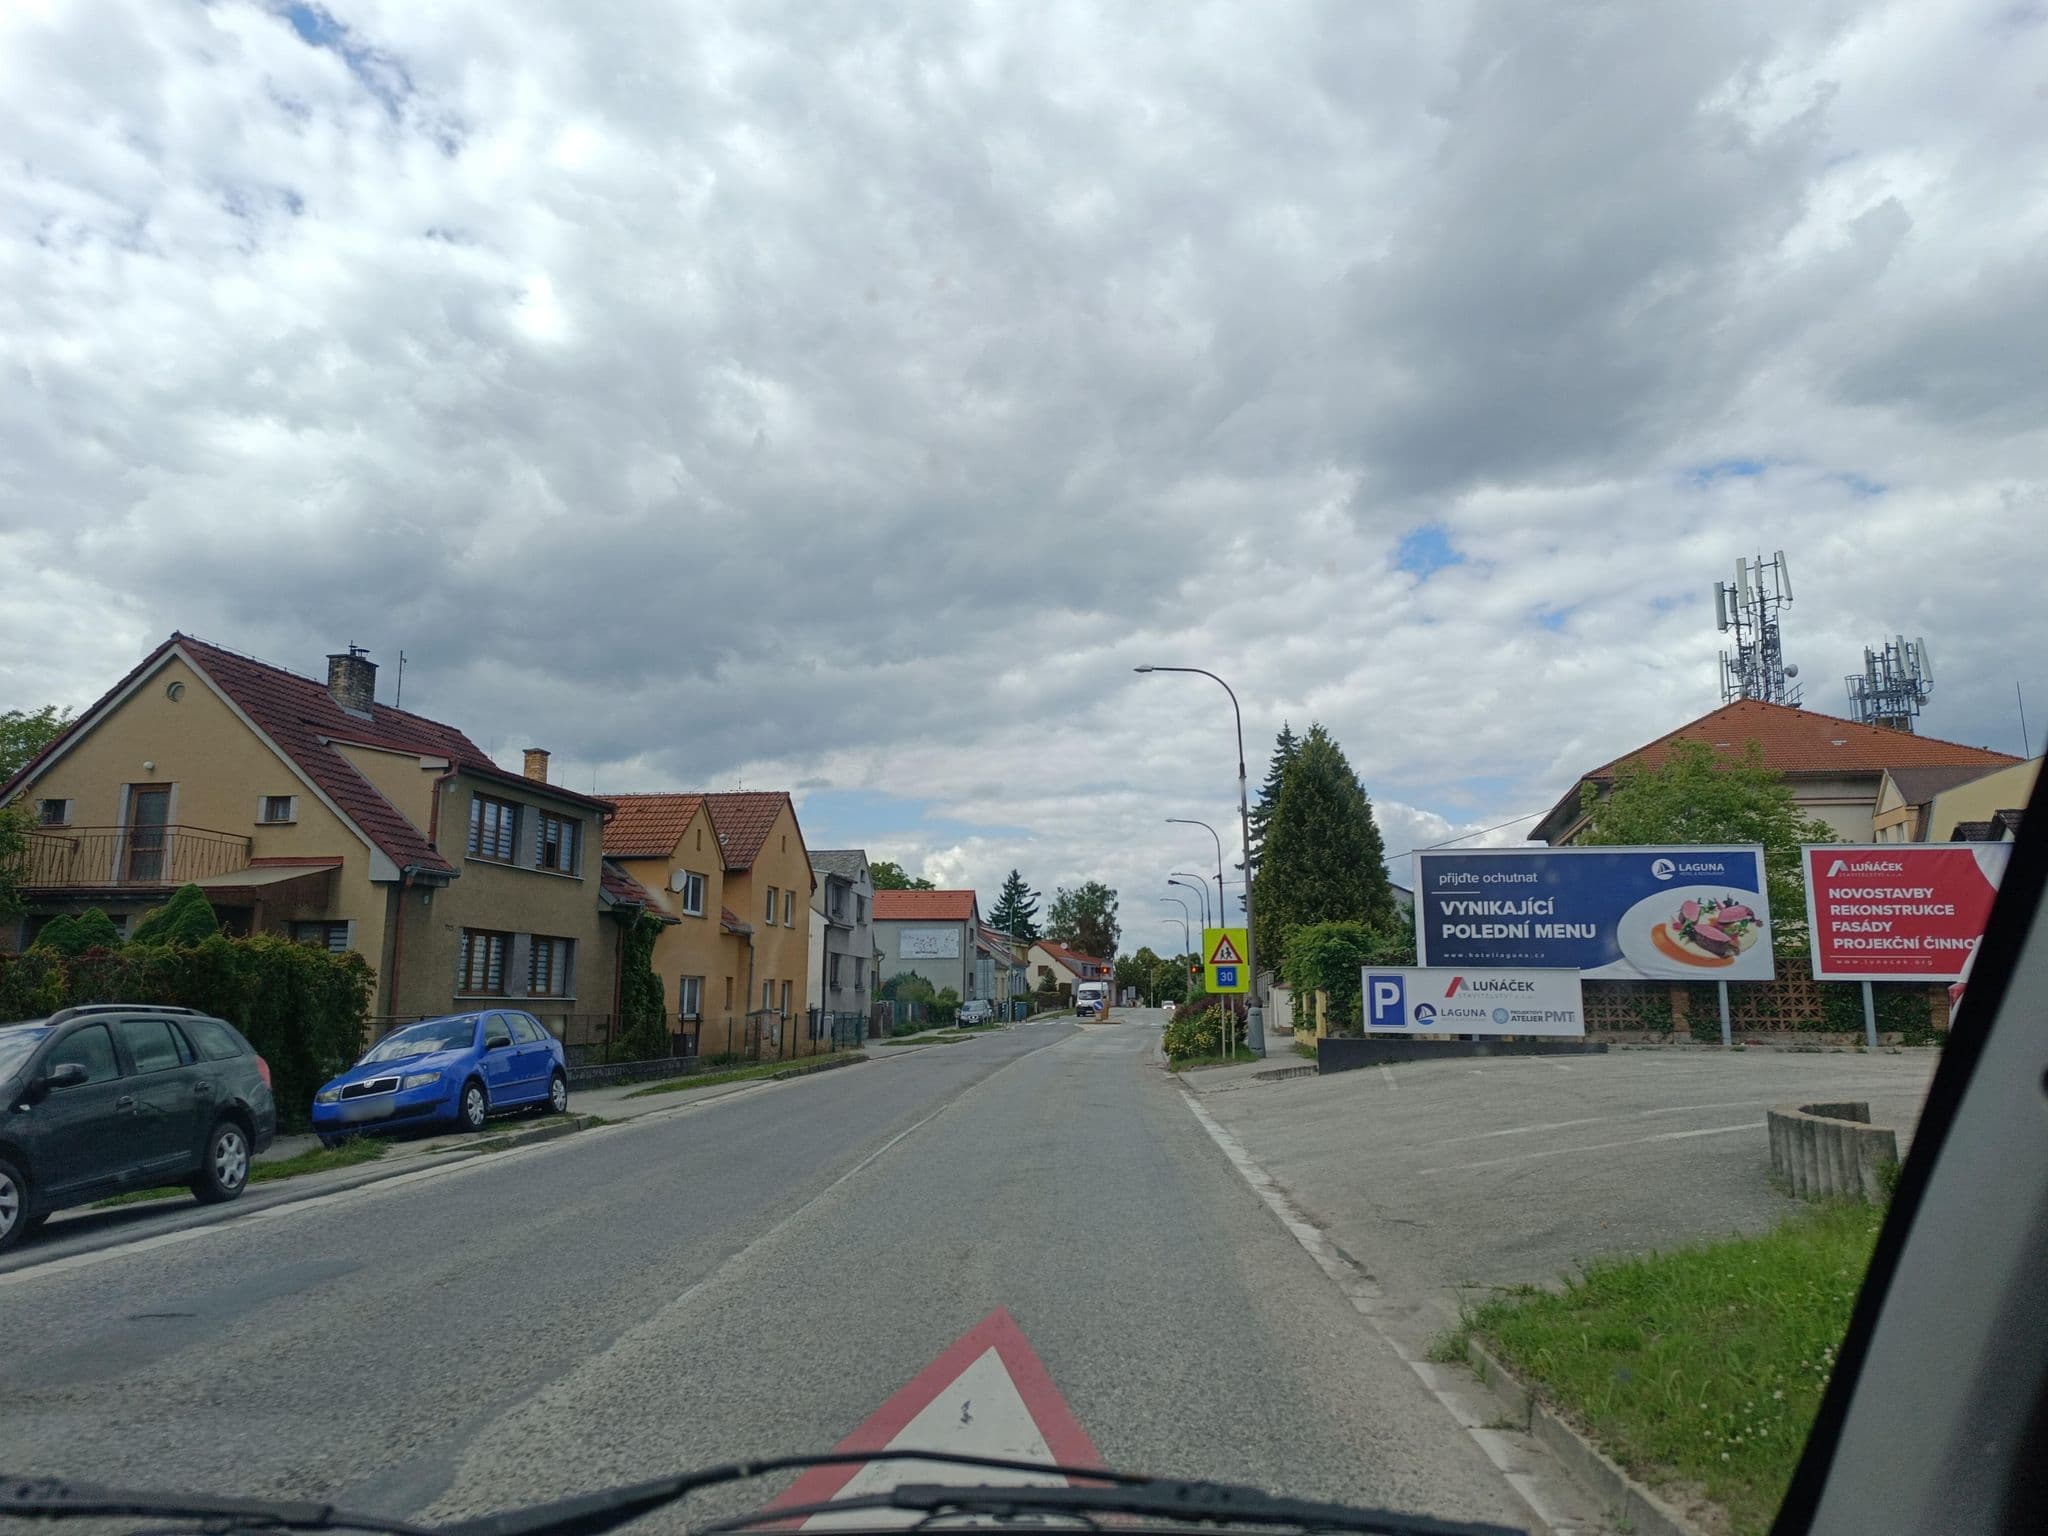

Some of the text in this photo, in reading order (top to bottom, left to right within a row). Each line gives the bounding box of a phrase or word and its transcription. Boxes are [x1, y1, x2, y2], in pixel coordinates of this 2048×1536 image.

[1679, 863, 1725, 871] LAGUNA
[1851, 861, 1903, 872] LUŇÁČEK
[1439, 872, 1539, 886] přijďte ochutnat
[1828, 887, 1934, 899] NOVOSTAVBY
[1440, 896, 1555, 916] VYNIKAJÍCÍ
[1830, 904, 1955, 916] REKONSTRUKCE
[1442, 920, 1597, 939] POLEDNÍ MENU
[1832, 920, 1893, 932] FASÁDY
[1833, 935, 1920, 949] PROJEKČNÍ
[1220, 971, 1233, 982] 30
[1472, 979, 1535, 992] LUŇÁČEK
[1374, 982, 1400, 1019] P
[1441, 1008, 1486, 1017] LAGUNA
[1544, 1011, 1574, 1023] PMT
